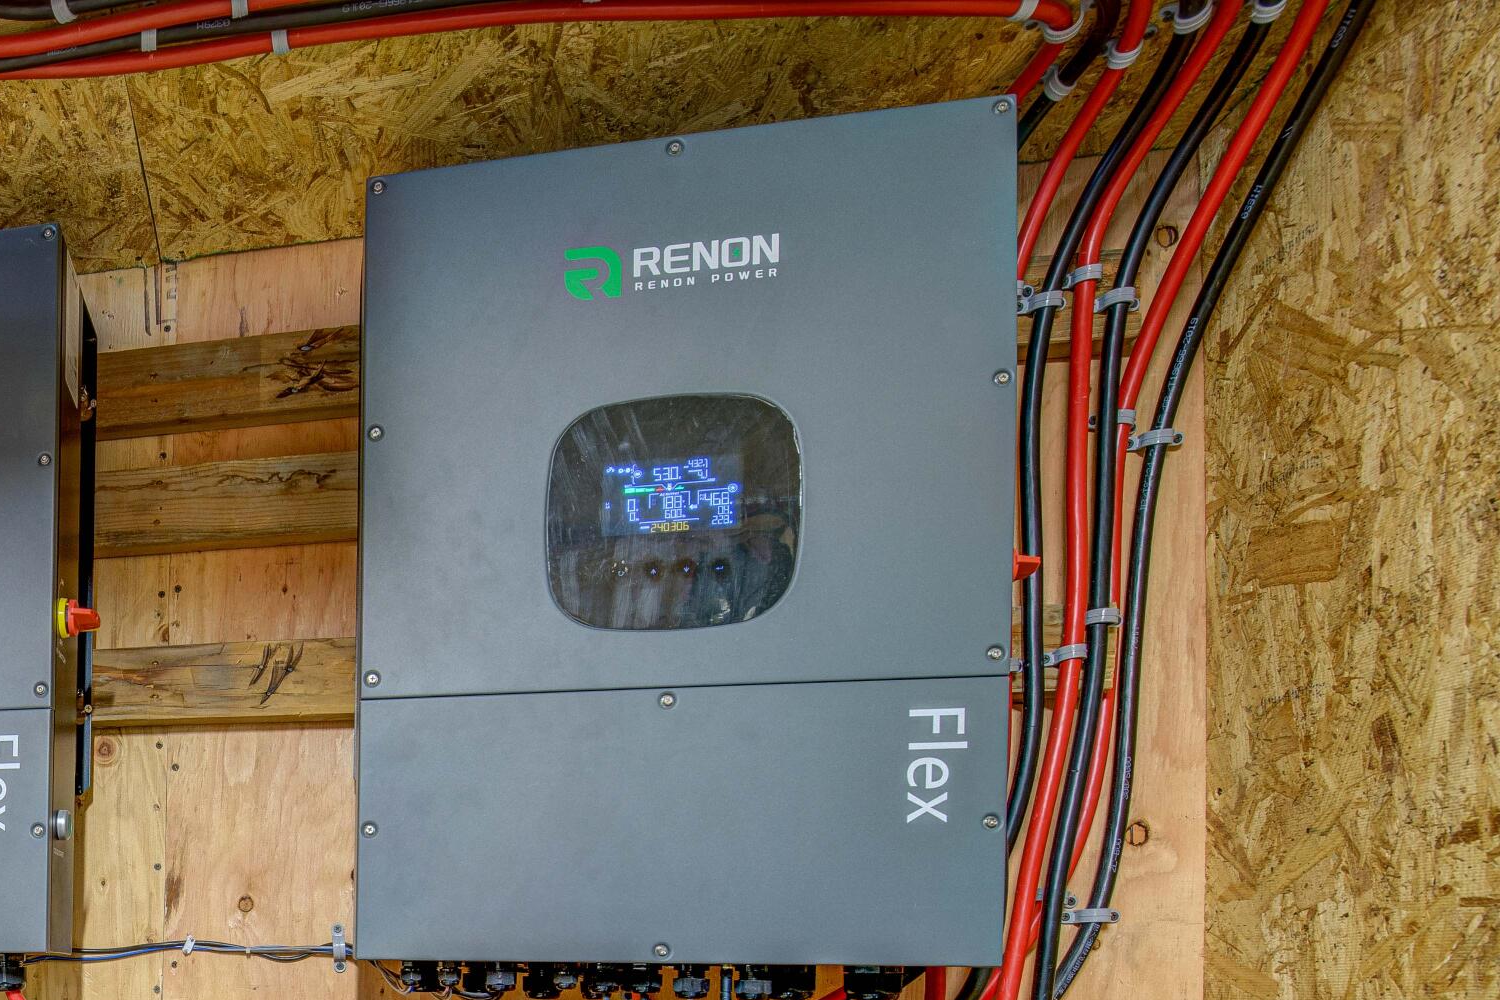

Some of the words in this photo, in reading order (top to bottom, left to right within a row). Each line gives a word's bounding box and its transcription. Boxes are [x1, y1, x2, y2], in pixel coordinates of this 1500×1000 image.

[633, 233, 780, 277] RENON
[634, 276, 695, 291] RENON
[711, 268, 778, 283] POWER
[906, 708, 968, 823] Flex
